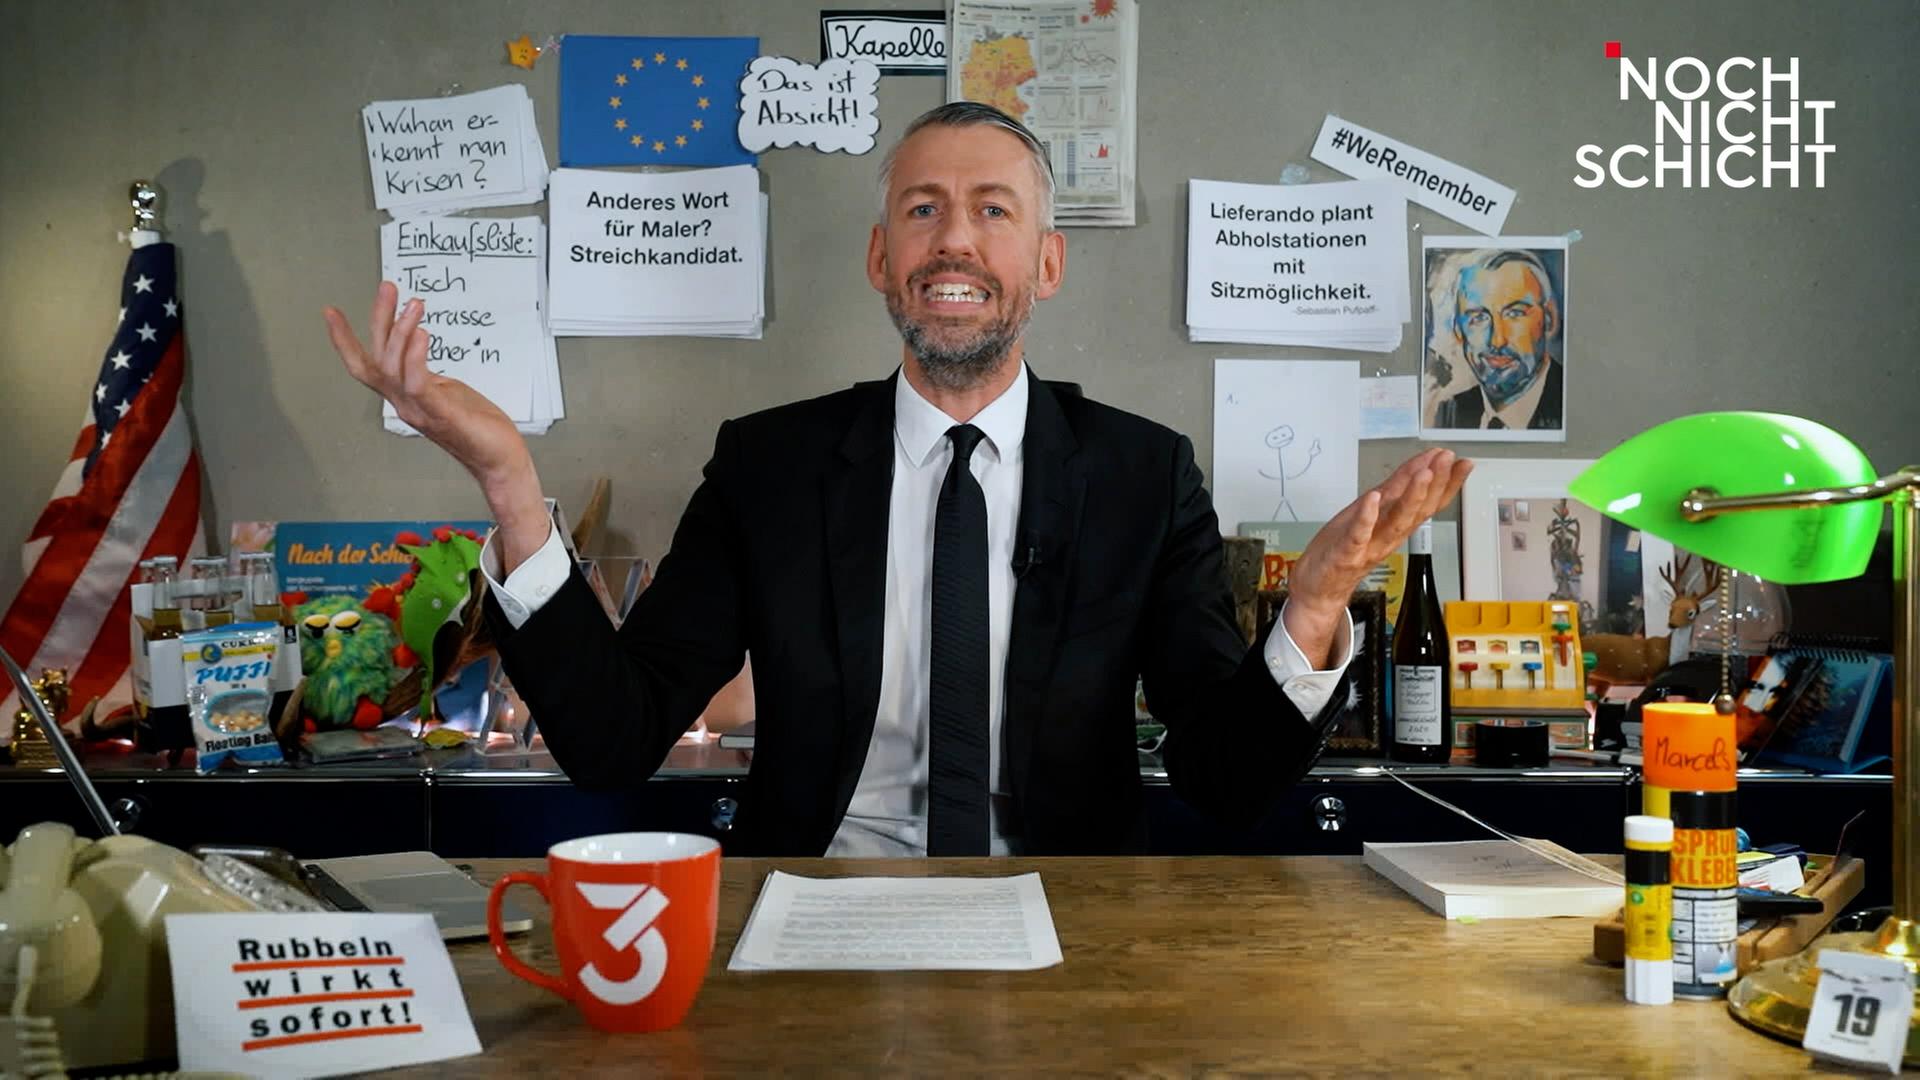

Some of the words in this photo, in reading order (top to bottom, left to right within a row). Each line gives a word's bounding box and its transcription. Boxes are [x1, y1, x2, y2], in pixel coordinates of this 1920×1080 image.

[835, 24, 946, 61] Kapelle
[757, 69, 813, 93] Das
[828, 70, 856, 93] ist
[377, 106, 454, 134] Wuhan
[758, 97, 859, 128] Absicht!
[381, 134, 443, 163] kennt
[459, 140, 507, 158] man
[1331, 127, 1497, 215] #WeRemember
[586, 191, 676, 211] Anderes
[682, 191, 729, 210] Wort
[1210, 202, 1315, 222] Lieferando
[1321, 204, 1374, 225] plant
[398, 220, 533, 263] Einkaufsliste:
[604, 219, 635, 237] für
[641, 219, 712, 238] Maler?
[1215, 229, 1367, 249] Abholstationen
[570, 244, 744, 265] Streichkandidat.
[1273, 258, 1305, 275] mit
[402, 265, 466, 293] Tisch
[1210, 281, 1371, 304] Sitzmöglichkeit.
[403, 299, 496, 327] rrasse
[287, 543, 333, 565] Nach
[337, 543, 367, 565] der
[238, 936, 393, 961] Rubbeln
[575, 881, 671, 1006] 3
[244, 968, 403, 997] wirkt
[250, 1001, 412, 1038] sofort!
[1834, 994, 1882, 1037] 19
